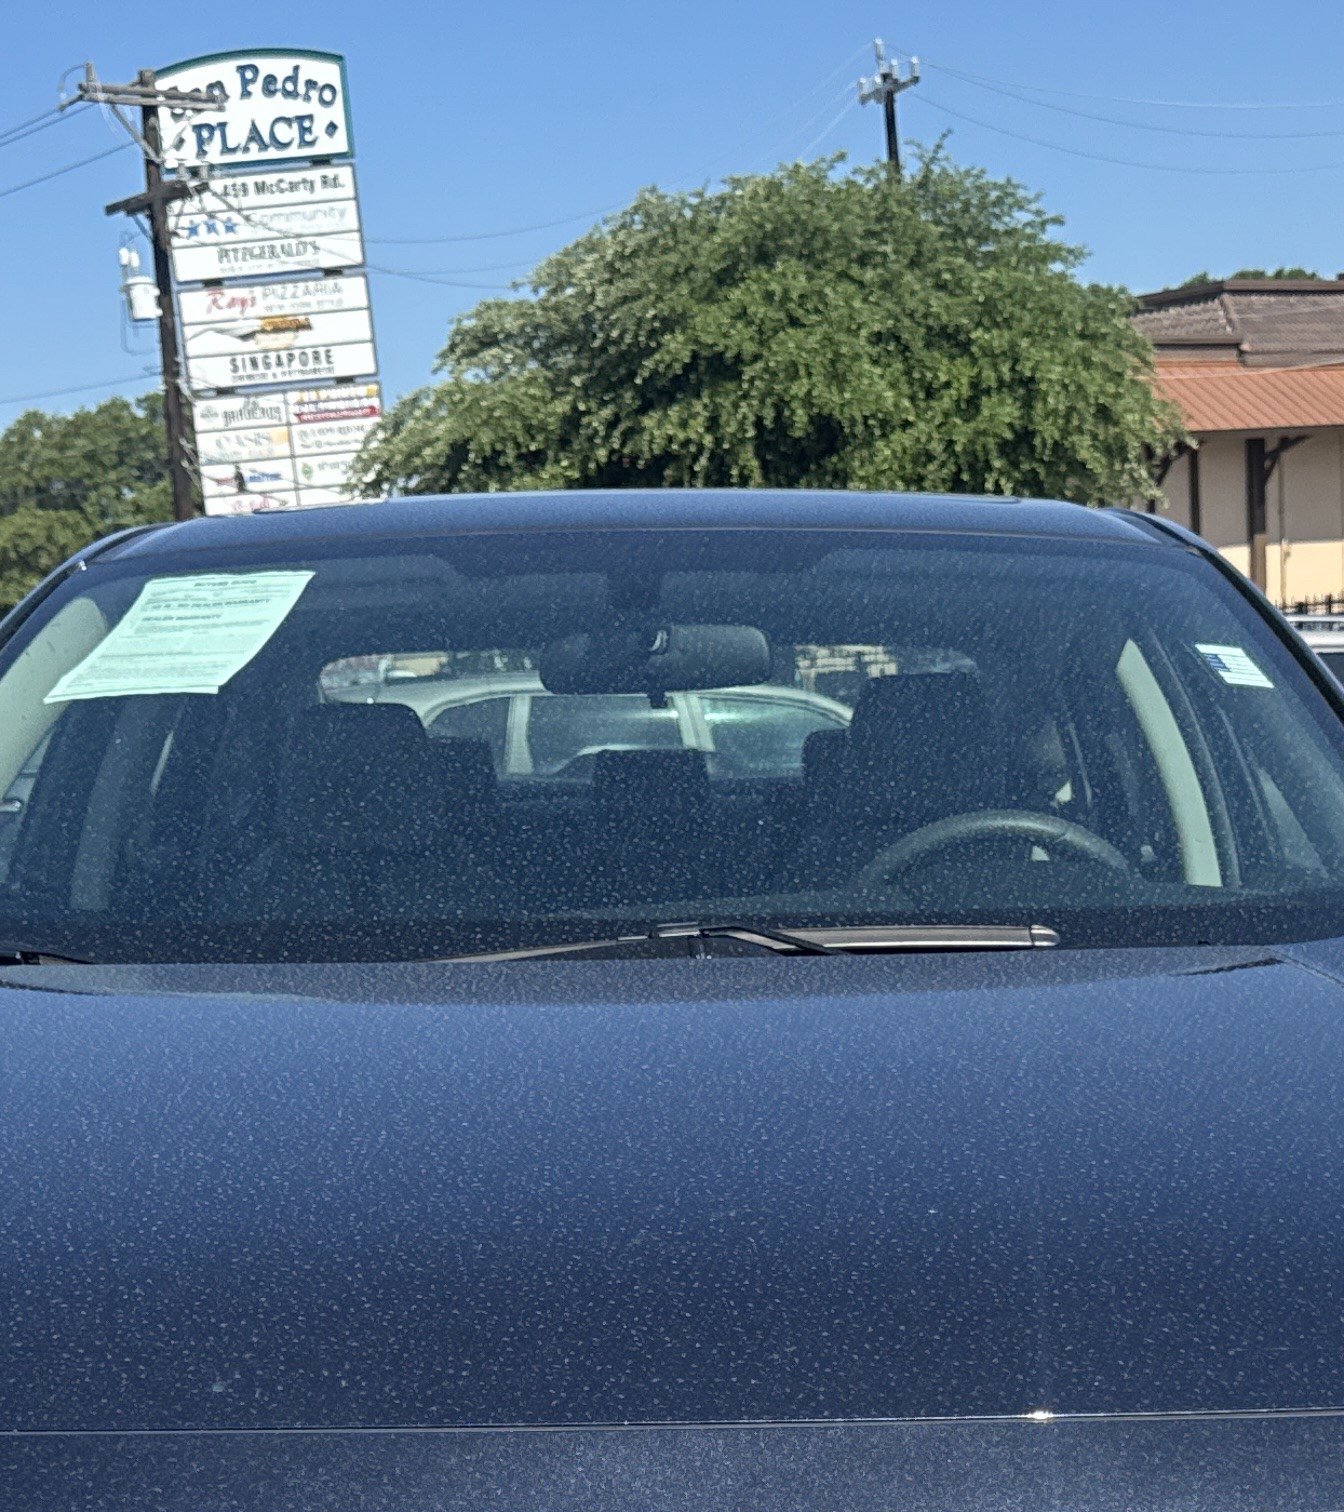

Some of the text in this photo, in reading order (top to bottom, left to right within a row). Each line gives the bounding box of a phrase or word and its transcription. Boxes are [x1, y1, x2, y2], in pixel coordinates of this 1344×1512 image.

[236, 64, 337, 108] Pedro
[192, 114, 319, 158] PLACE
[253, 177, 316, 196] McCarty
[229, 349, 335, 374] SINGAPORE
